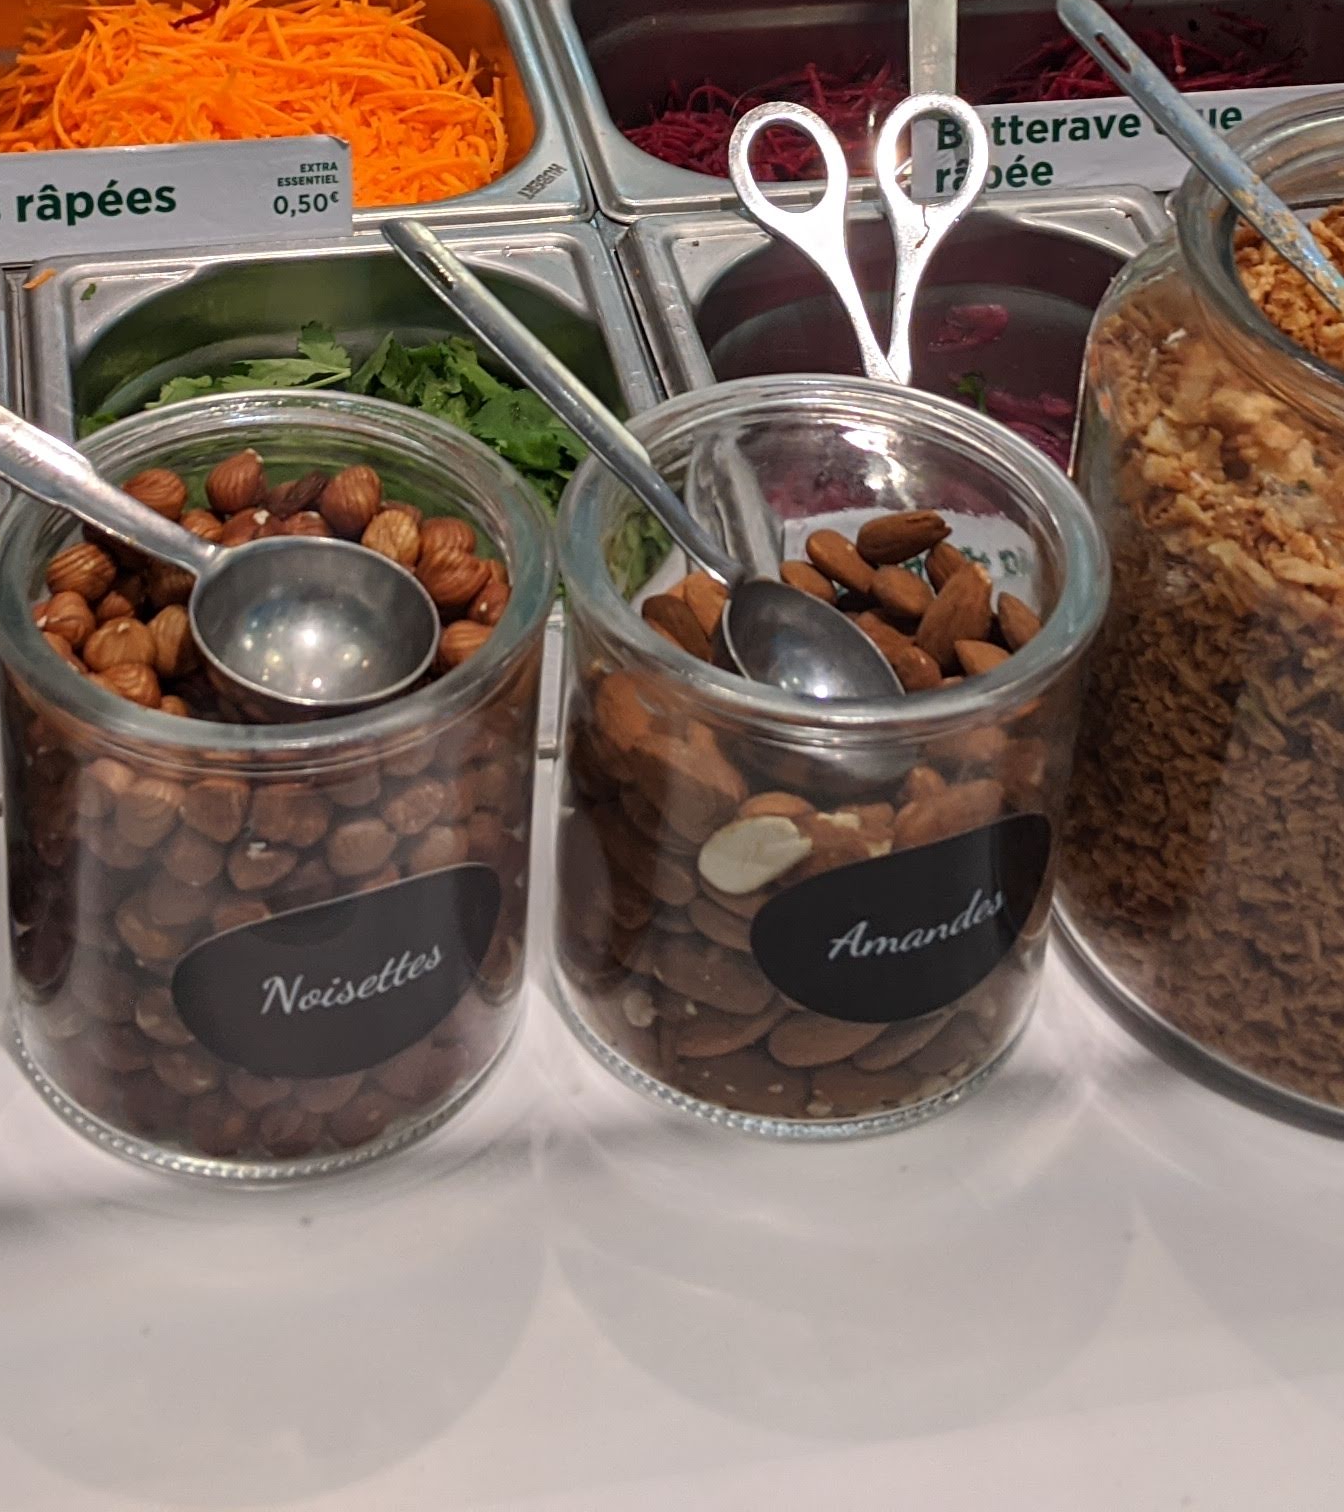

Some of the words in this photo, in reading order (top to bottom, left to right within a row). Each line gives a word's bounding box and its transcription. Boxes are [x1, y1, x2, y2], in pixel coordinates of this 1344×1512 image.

[937, 109, 1141, 150] Btterave
[277, 174, 339, 187] ESSENTIEL
[299, 161, 338, 173] EXTRA
[16, 179, 177, 227] râpées
[273, 191, 339, 217] 0,50€
[260, 943, 443, 1016] Noisettes
